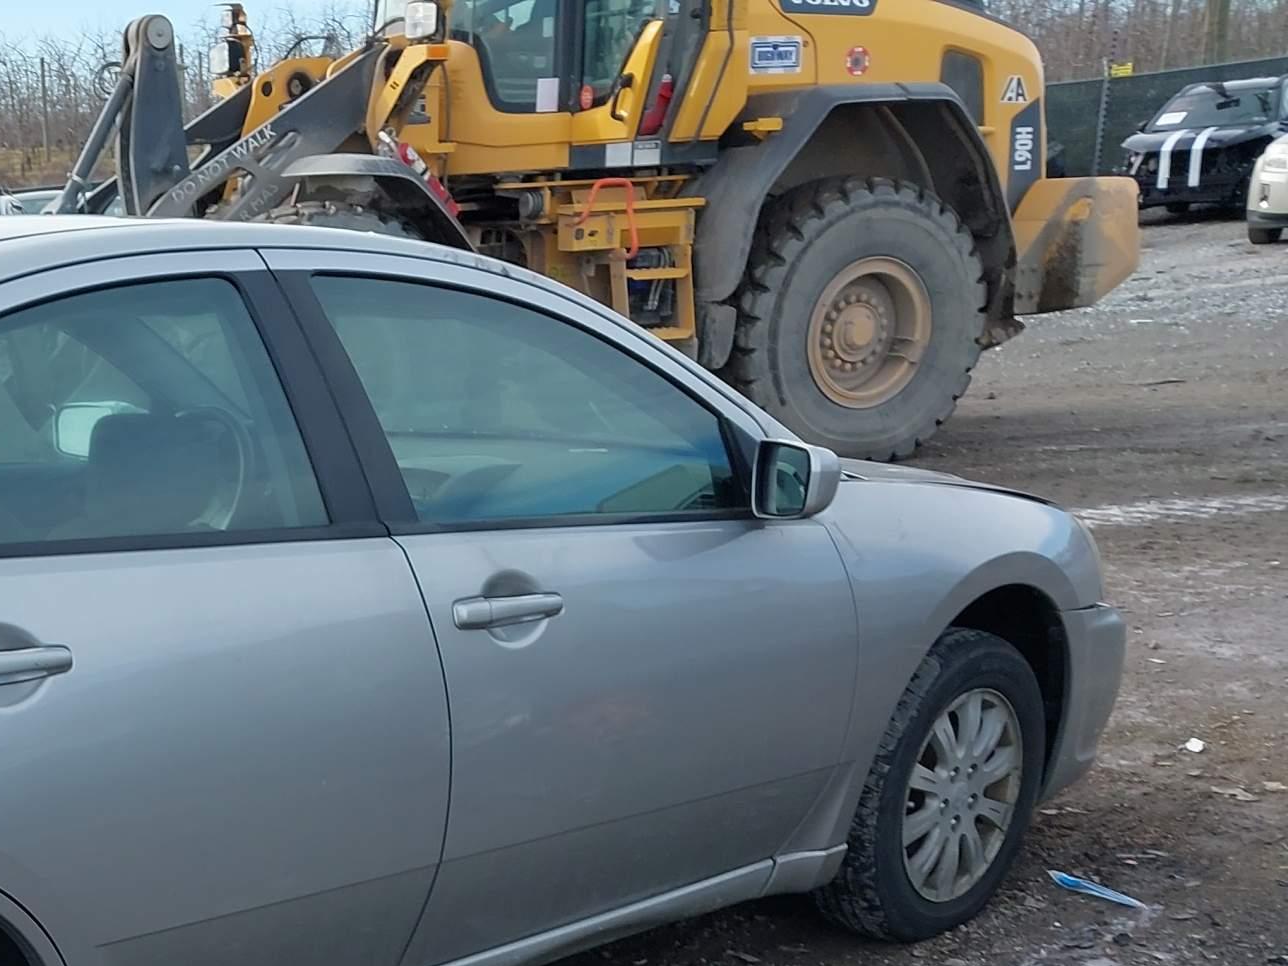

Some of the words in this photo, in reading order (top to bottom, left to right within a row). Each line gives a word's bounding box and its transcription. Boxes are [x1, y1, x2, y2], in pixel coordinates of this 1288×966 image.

[172, 181, 196, 201] DO
[198, 156, 231, 183] NOT
[231, 124, 277, 159] WALK
[1013, 126, 1034, 171] L90H
